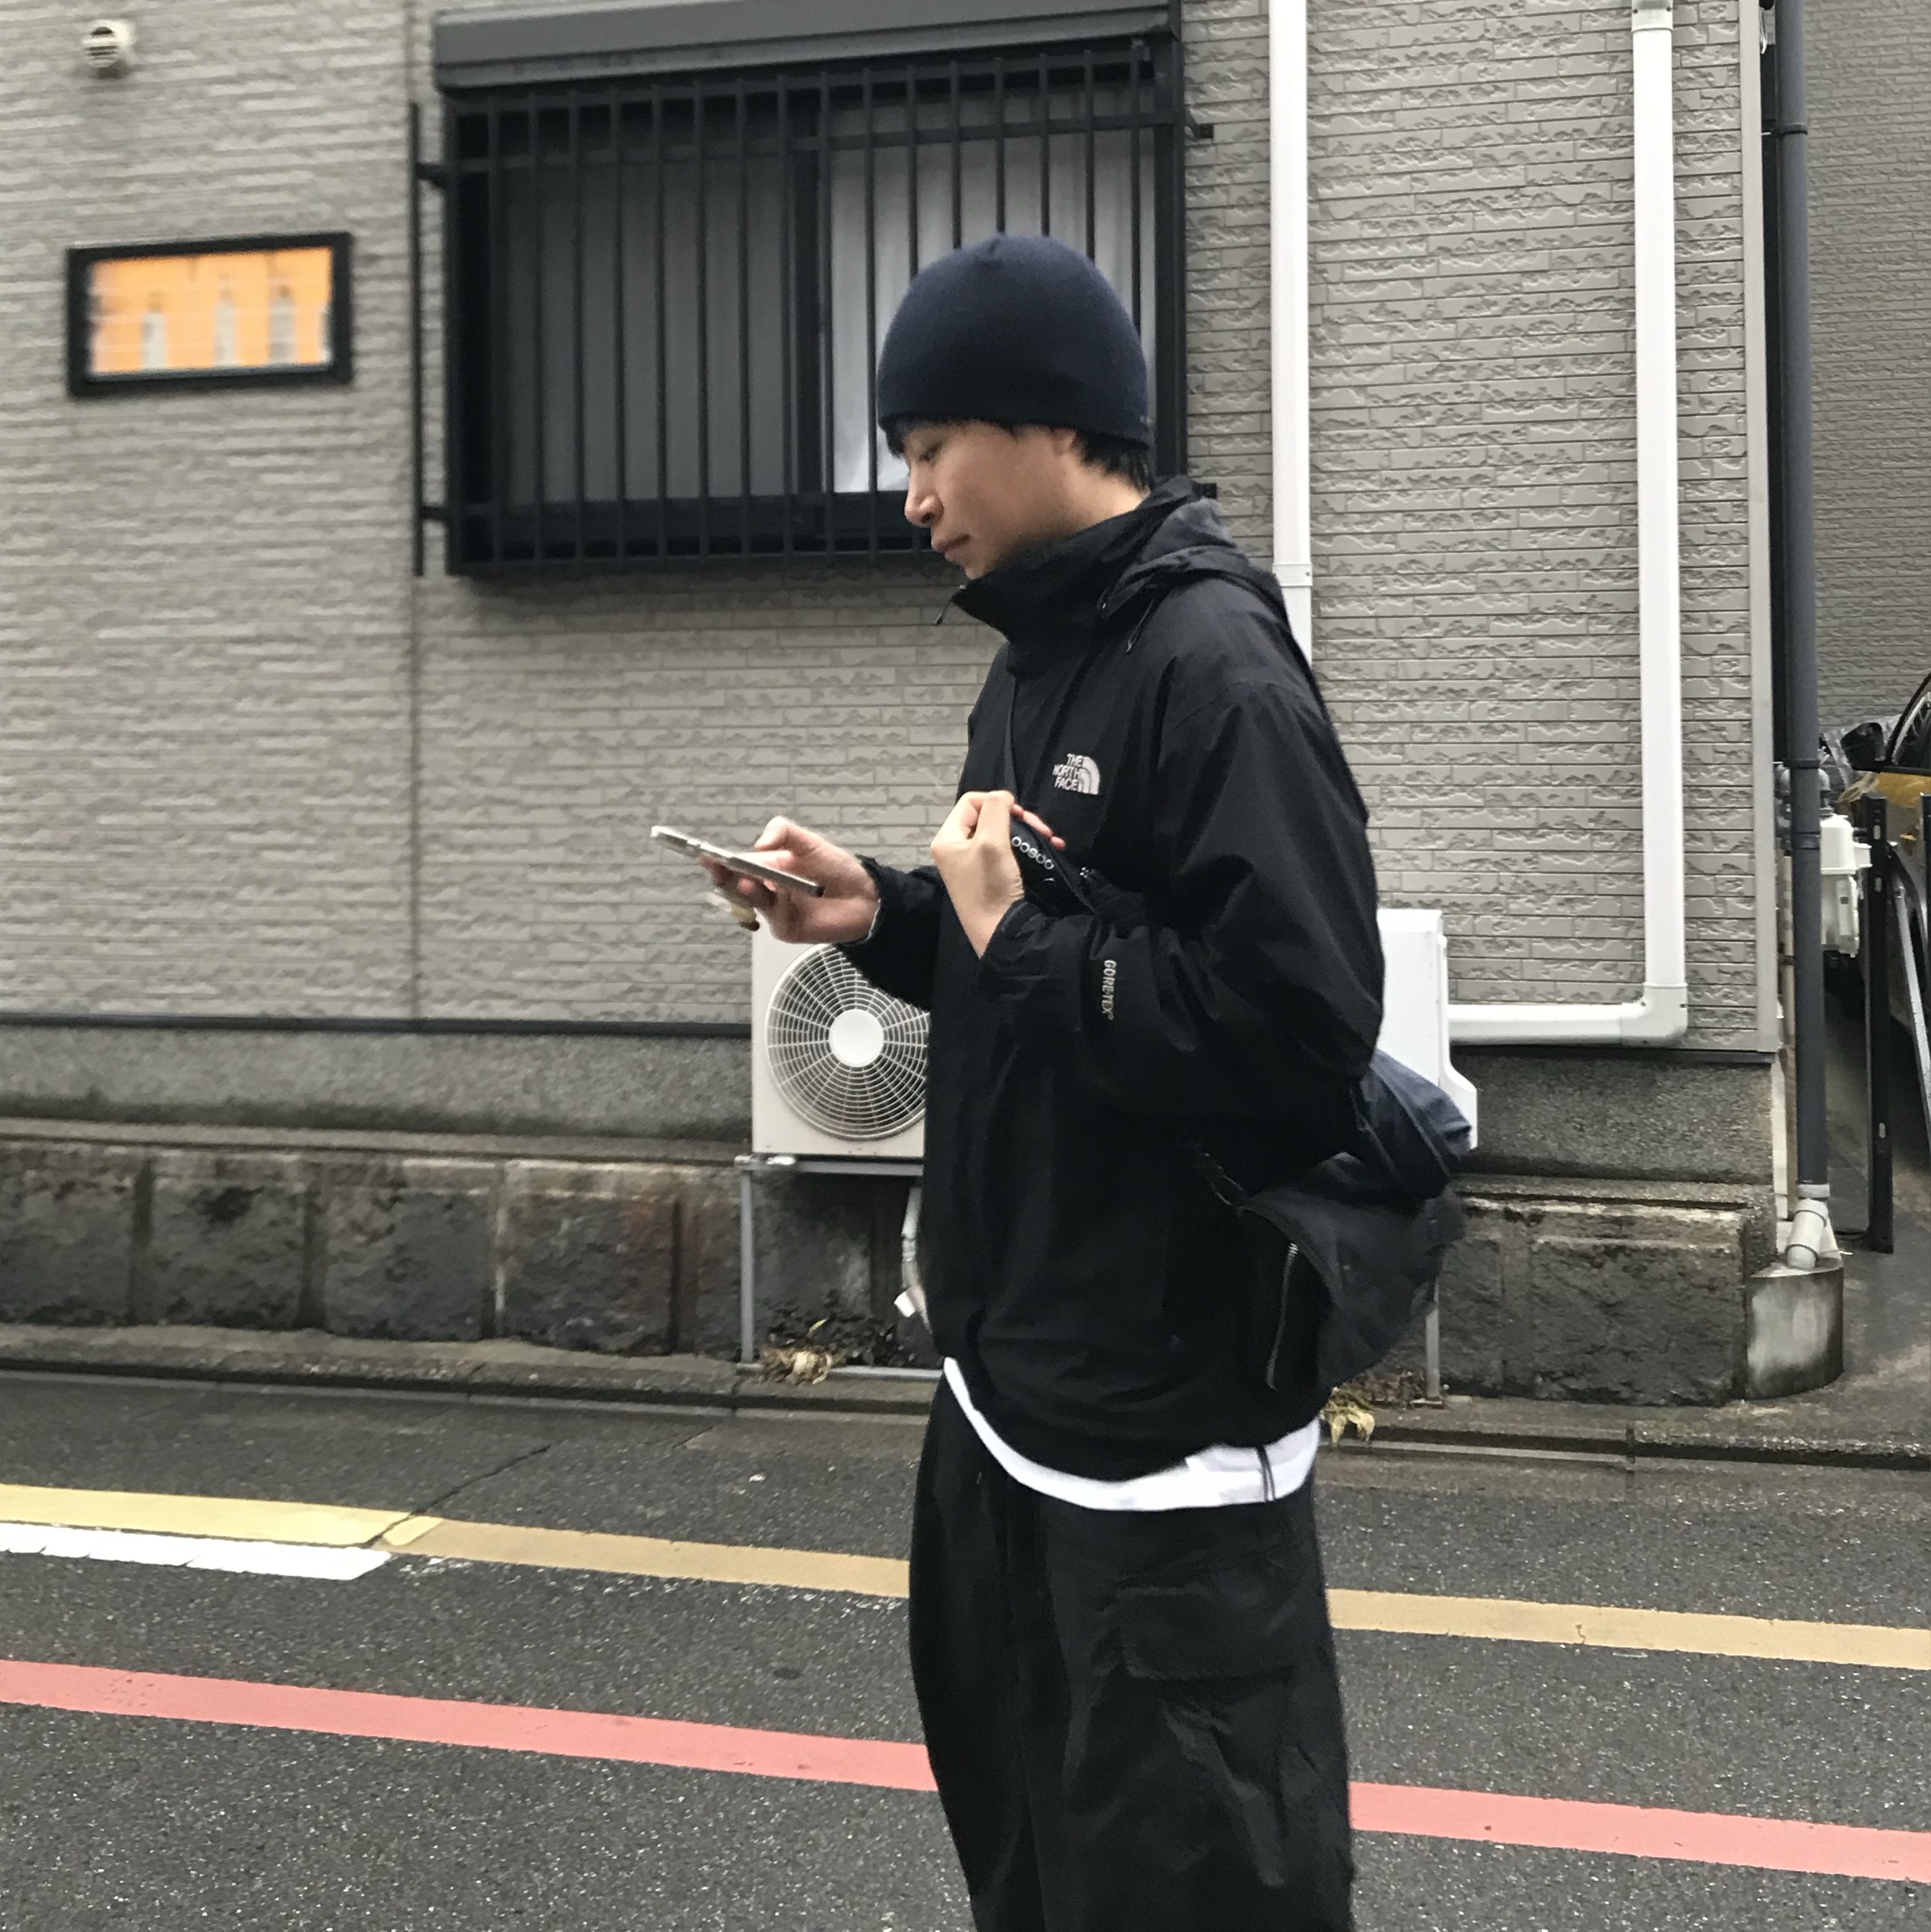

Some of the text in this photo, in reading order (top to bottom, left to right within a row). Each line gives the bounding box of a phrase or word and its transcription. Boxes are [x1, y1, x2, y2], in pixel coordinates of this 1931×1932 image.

[1067, 753, 1084, 767] THE
[1052, 763, 1079, 779] NORTH
[1054, 776, 1078, 791] FACE
